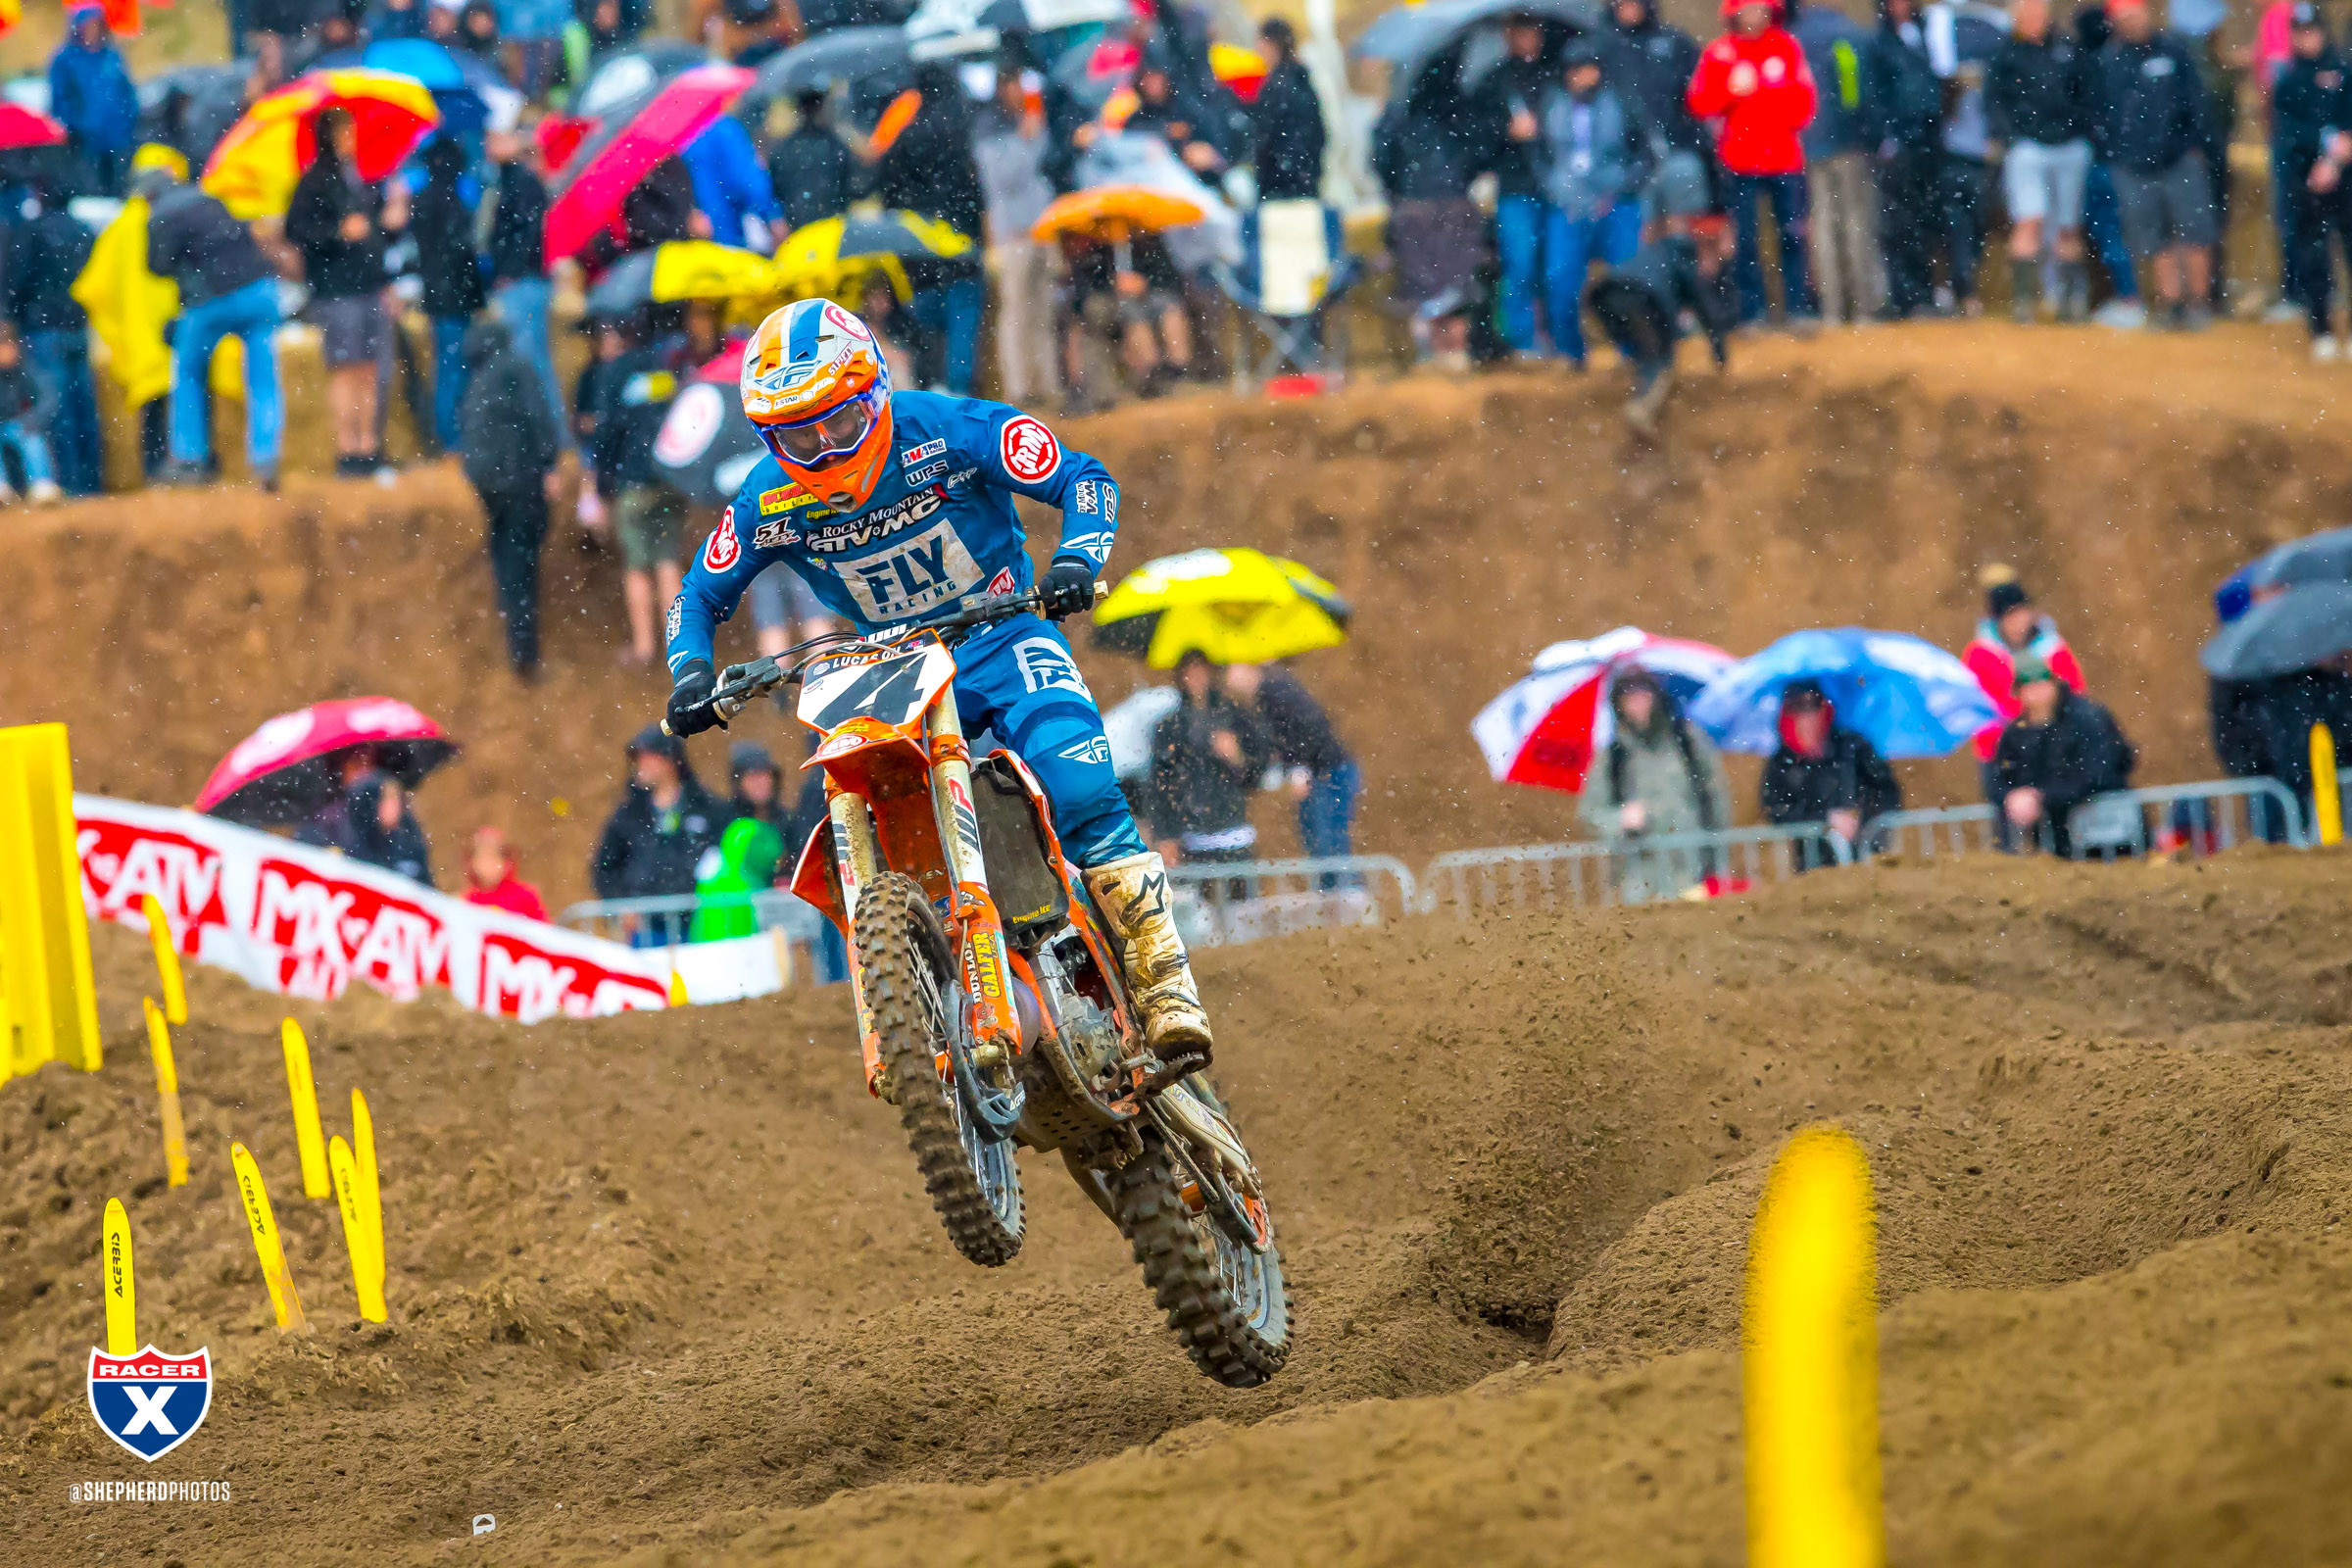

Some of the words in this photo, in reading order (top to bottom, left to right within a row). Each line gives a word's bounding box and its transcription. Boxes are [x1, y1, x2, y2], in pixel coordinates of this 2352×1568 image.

[903, 445, 929, 466] AMA
[927, 440, 944, 451] PRO
[906, 461, 949, 486] WPS
[755, 517, 789, 543] 51
[807, 509, 830, 519] Engine
[822, 517, 865, 538] ROCKY
[868, 486, 934, 525] MOUNTAIN
[855, 535, 949, 605] FLY
[877, 581, 956, 614] RACING
[812, 651, 928, 731] 4
[972, 933, 1001, 998] GALFER
[112, 1232, 123, 1298] ACERBIS
